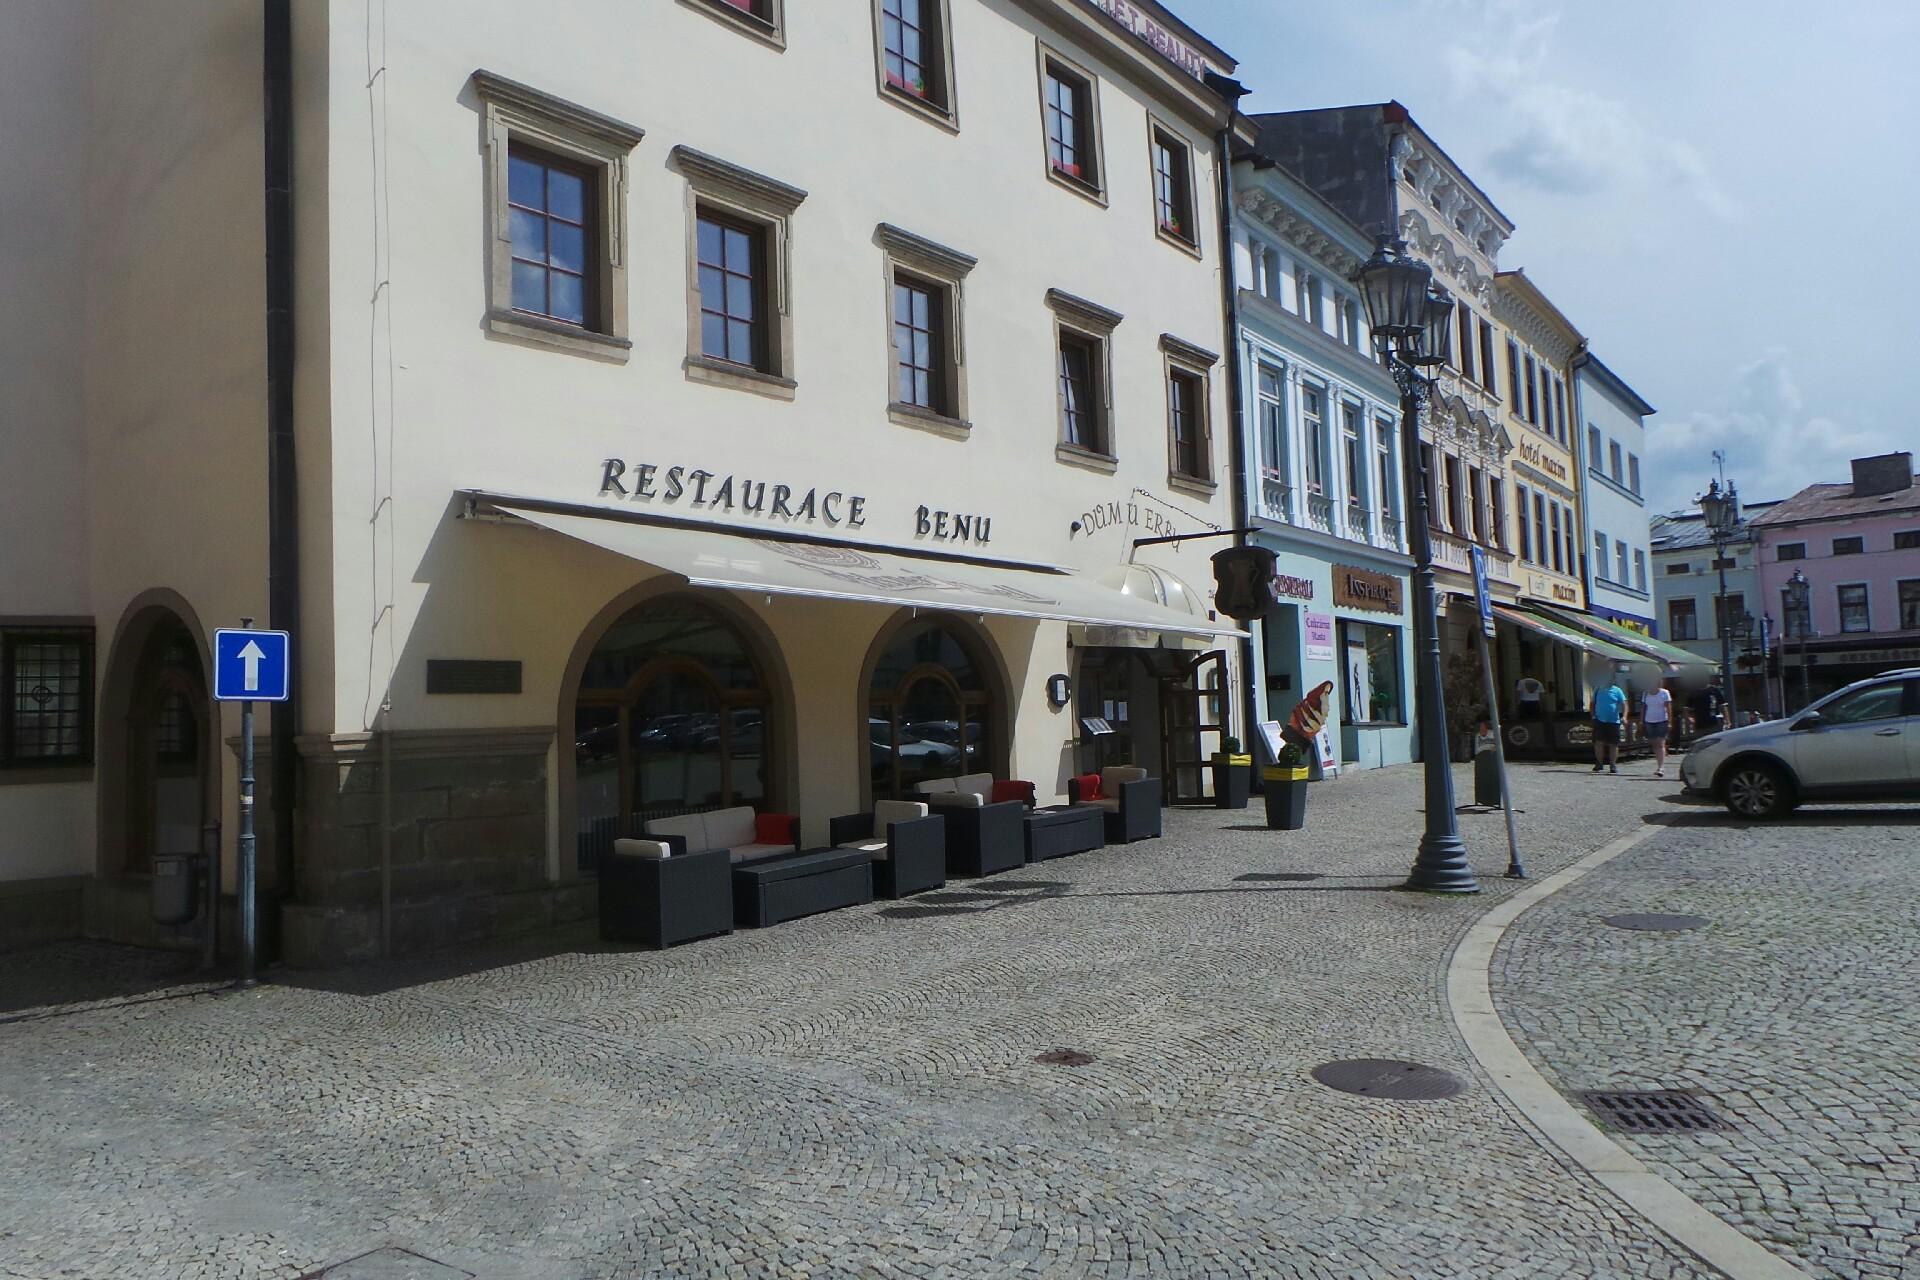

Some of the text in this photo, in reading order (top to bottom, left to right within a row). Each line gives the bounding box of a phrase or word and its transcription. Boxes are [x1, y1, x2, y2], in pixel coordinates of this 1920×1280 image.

[1145, 19, 1205, 82] REALITY
[1519, 433, 1566, 481] hotel maxim
[601, 458, 991, 543] RESTAURACE BENU
[1127, 503, 1138, 526] U
